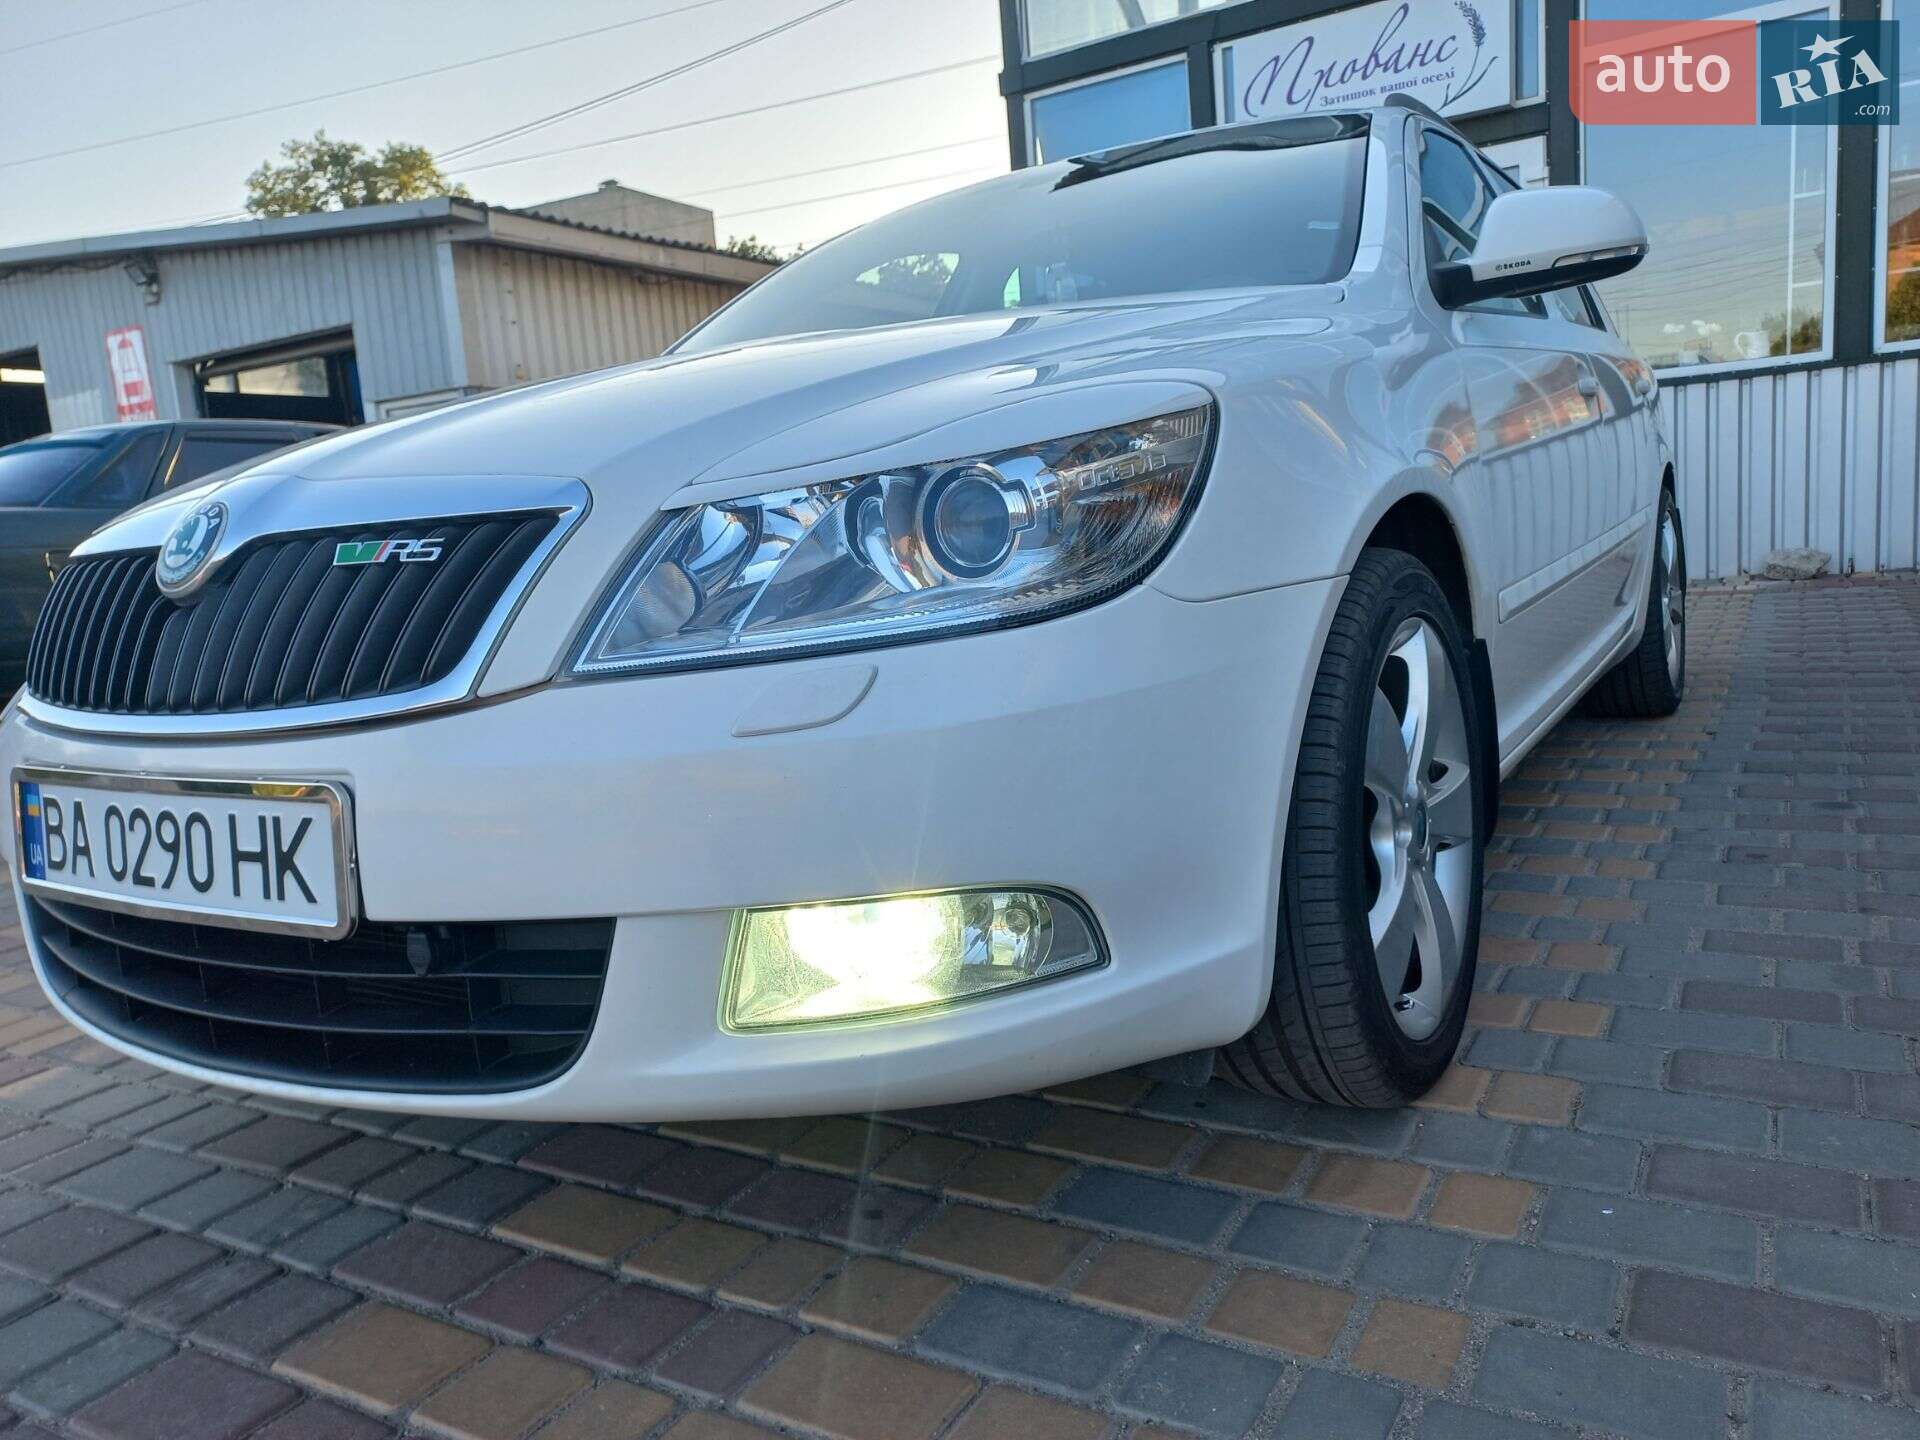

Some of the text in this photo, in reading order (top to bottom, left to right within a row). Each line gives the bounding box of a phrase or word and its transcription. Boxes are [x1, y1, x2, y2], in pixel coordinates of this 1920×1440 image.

[1243, 2, 1458, 118] Прованс
[1319, 87, 1377, 107] Затишок
[1420, 67, 1456, 85] оселі
[30, 844, 44, 865] UA
[43, 796, 318, 904] BA 0290 HK
